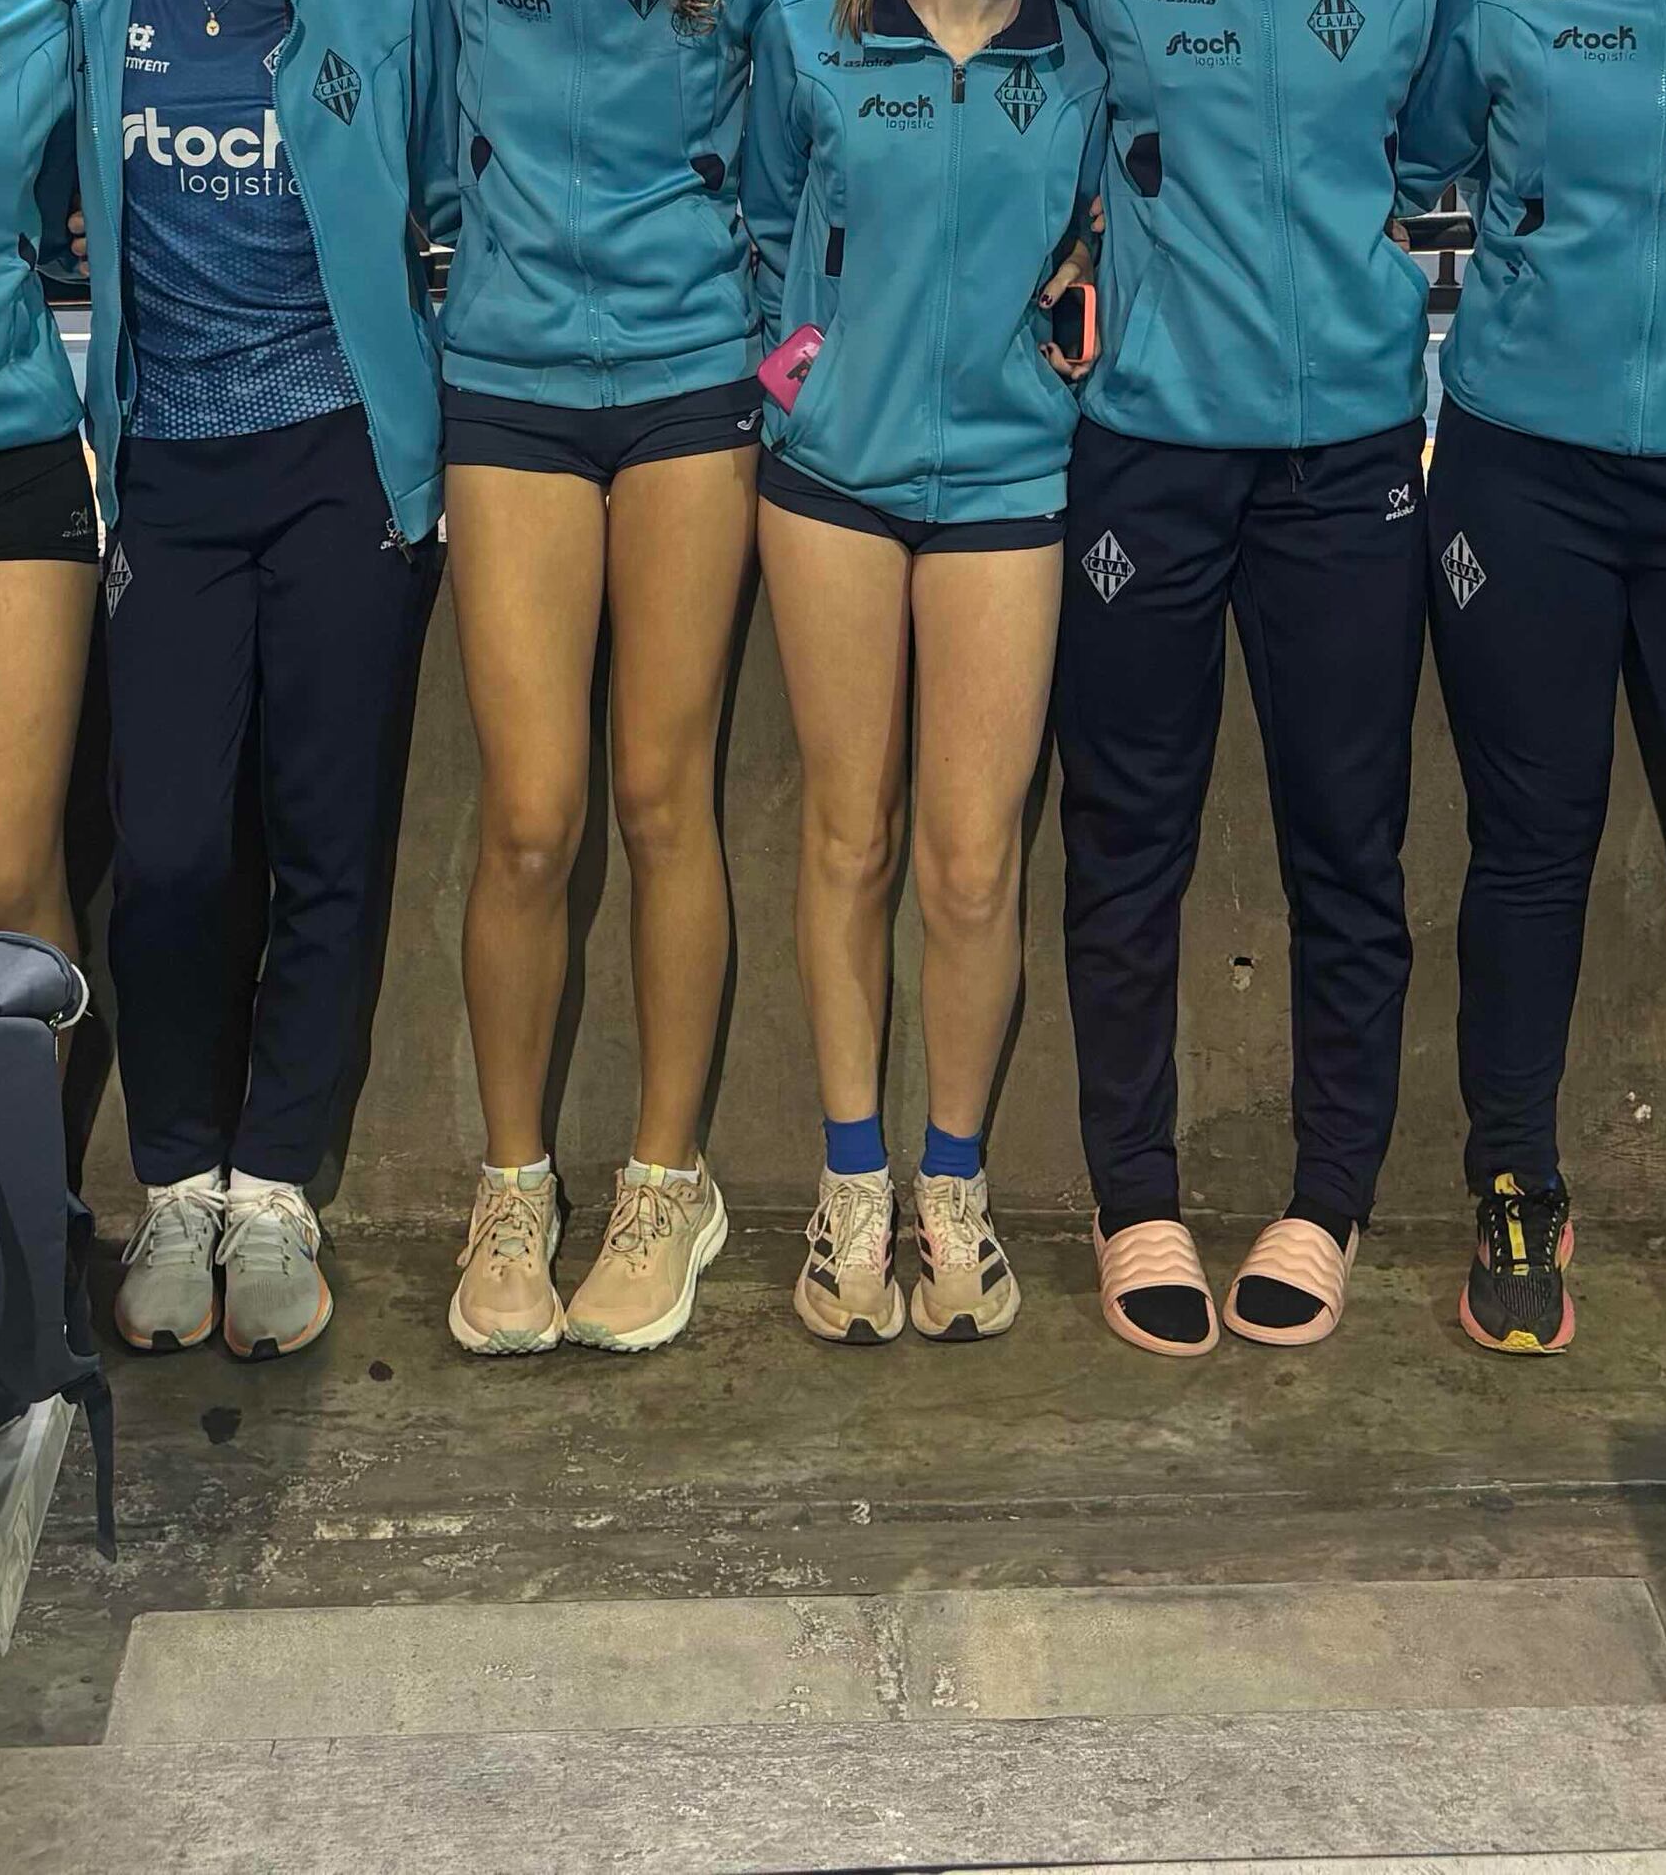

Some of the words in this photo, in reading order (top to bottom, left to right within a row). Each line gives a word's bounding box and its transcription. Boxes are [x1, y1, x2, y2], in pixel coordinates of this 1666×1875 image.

[1166, 29, 1242, 56] stock
[1553, 26, 1637, 50] stock
[1195, 56, 1242, 69] logistic
[1583, 51, 1637, 64] logistic
[858, 93, 934, 118] stock
[180, 167, 301, 201] logistic
[1088, 557, 1128, 577] C.A.V.A.
